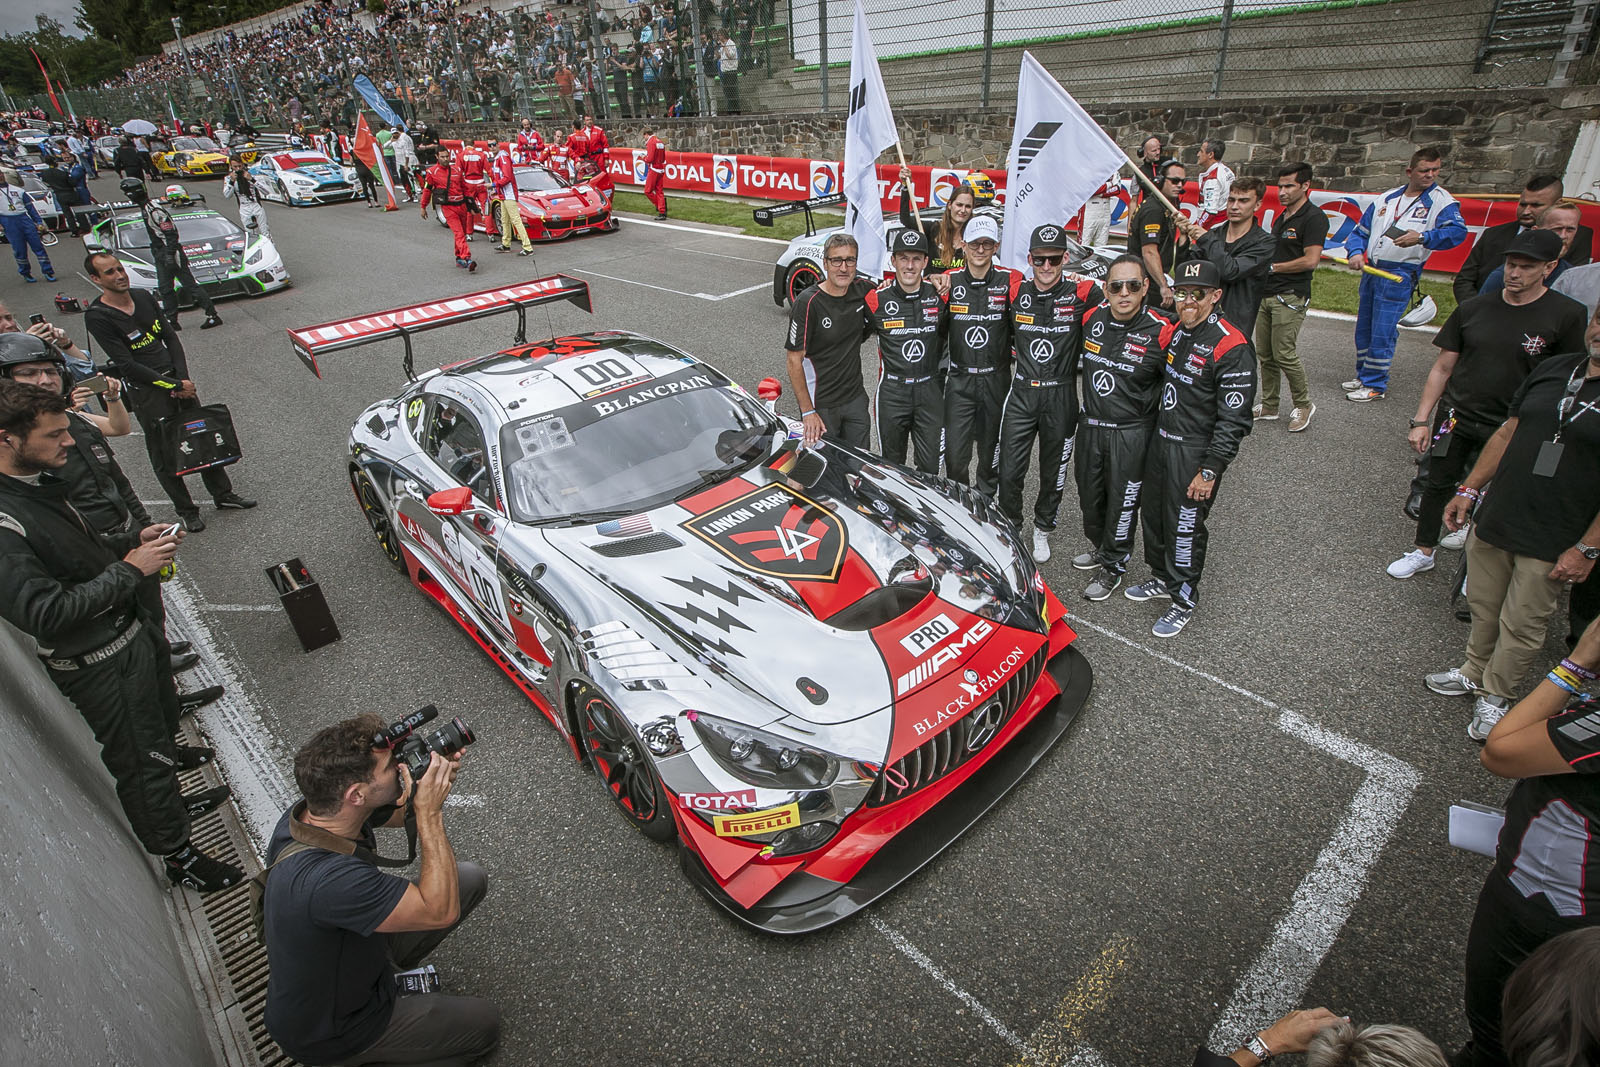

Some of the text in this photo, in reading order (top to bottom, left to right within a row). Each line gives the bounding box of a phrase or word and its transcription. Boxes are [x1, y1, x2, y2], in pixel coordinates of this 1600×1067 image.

[606, 160, 632, 175] TAL
[664, 162, 711, 182] OTAL
[739, 164, 806, 191] TOTAL
[878, 180, 925, 203] TAL
[574, 359, 632, 386] 00
[592, 374, 713, 417] BLANCPAIN
[520, 414, 555, 427] POSITION
[1061, 438, 1074, 462] PARK
[701, 491, 795, 536] LINKIN PARK
[1115, 480, 1142, 541] LINKIN PARK
[1175, 505, 1198, 567] LINKIN PARK
[909, 621, 950, 650] PRO
[84, 635, 127, 665] RINGERS
[913, 645, 1025, 736] BLACK FALCON
[680, 792, 756, 808] TOTAL
[722, 810, 792, 833] PIRELLI
